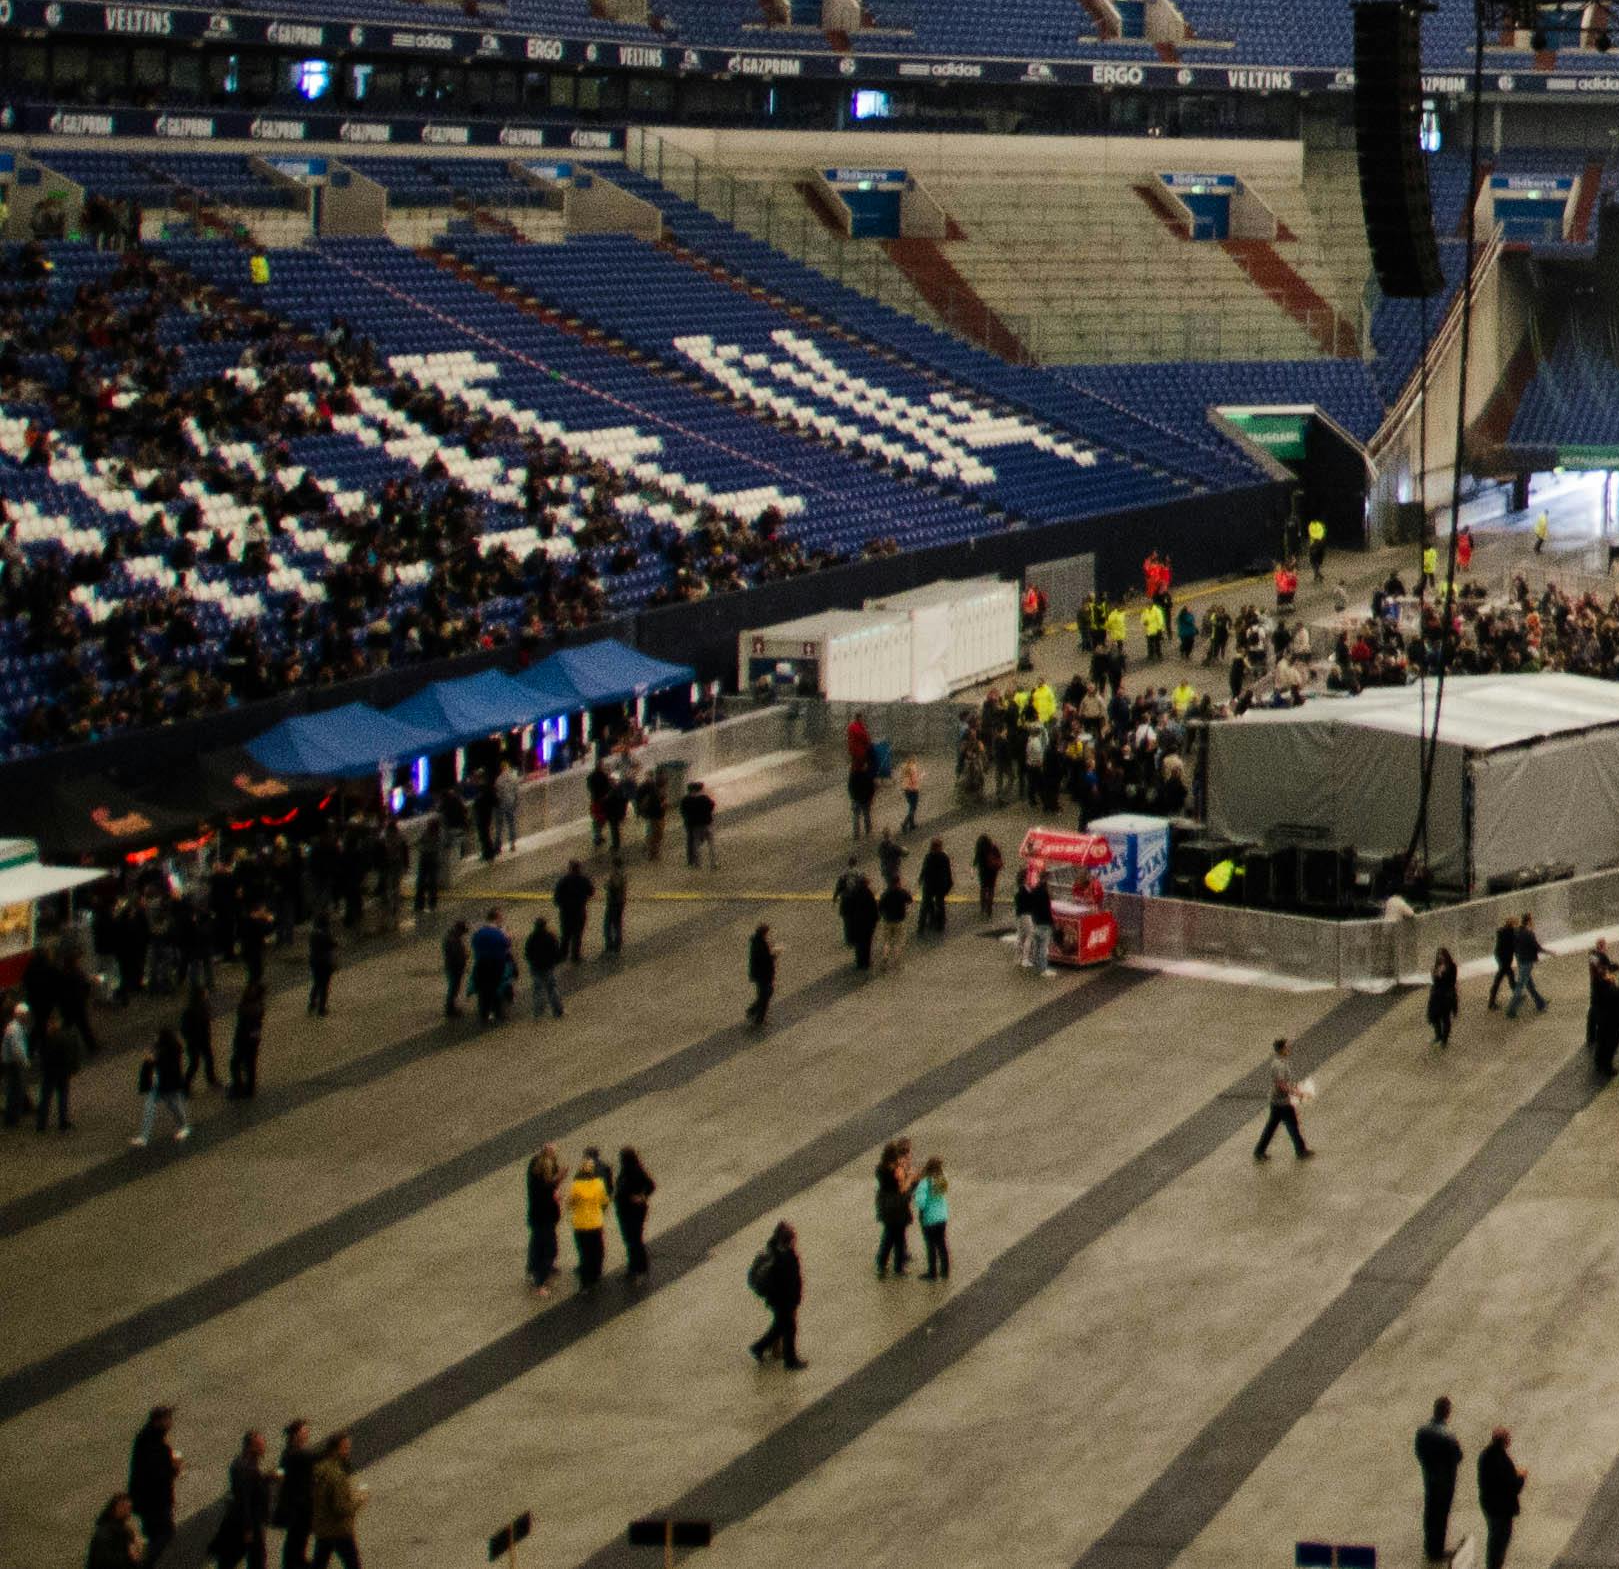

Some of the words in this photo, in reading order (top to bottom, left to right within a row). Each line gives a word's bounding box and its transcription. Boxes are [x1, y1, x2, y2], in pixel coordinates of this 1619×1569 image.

[106, 6, 172, 36] VELTINS
[526, 38, 565, 61] ERGO
[619, 45, 664, 69] VELTINS
[743, 57, 801, 76] GAZPROM
[931, 61, 983, 78] adidas
[1092, 64, 1145, 86] ERGO
[1227, 69, 1293, 91] VELTINS
